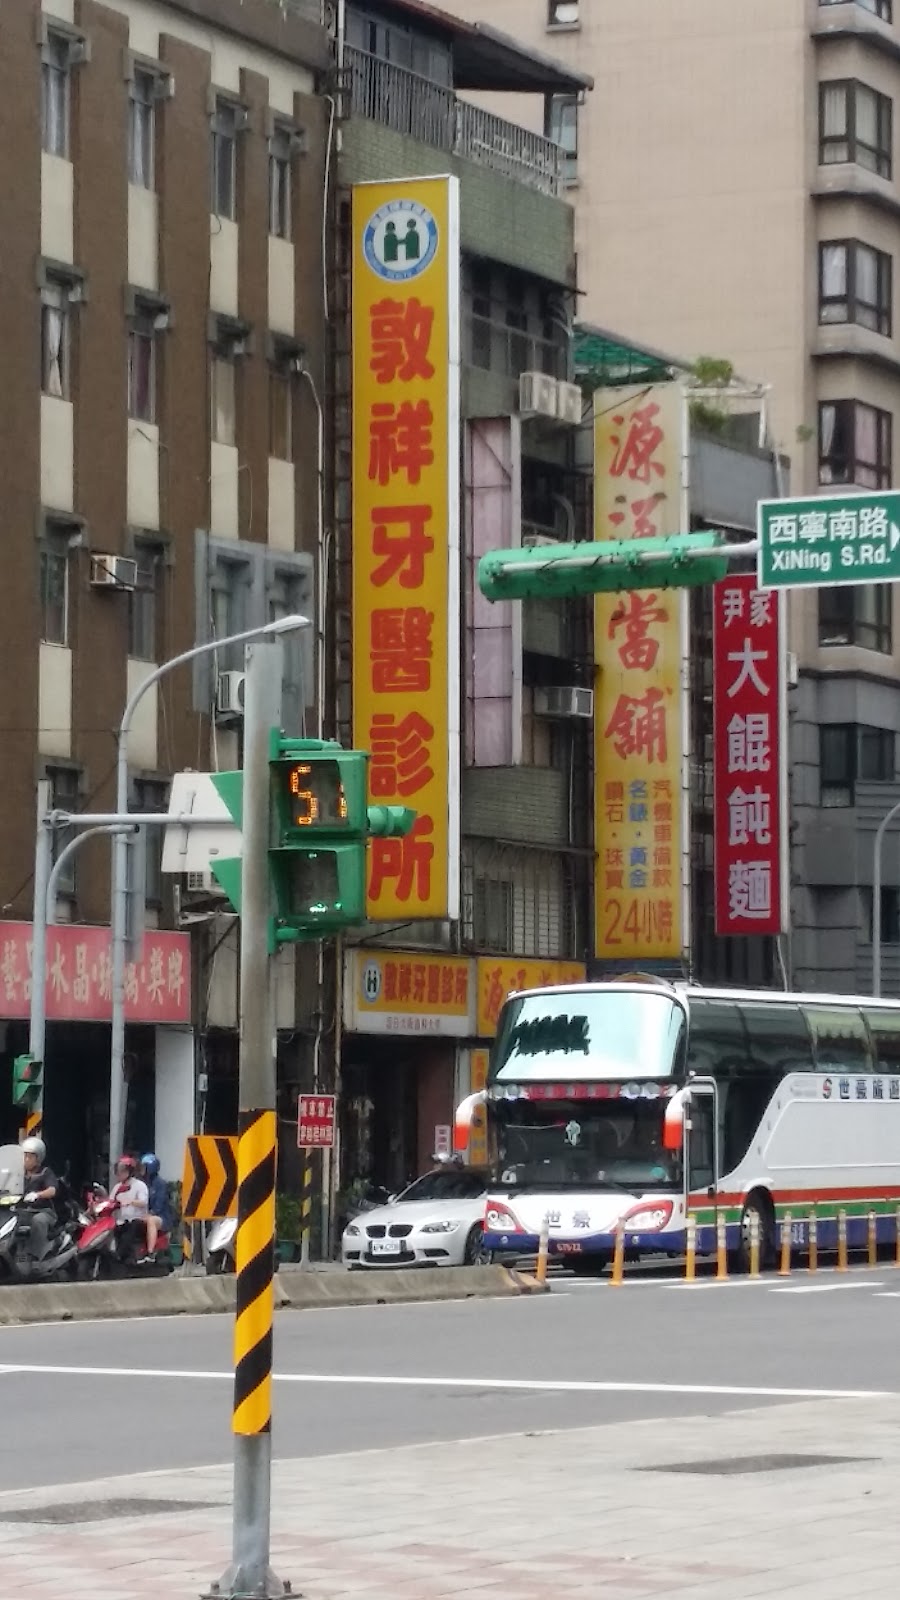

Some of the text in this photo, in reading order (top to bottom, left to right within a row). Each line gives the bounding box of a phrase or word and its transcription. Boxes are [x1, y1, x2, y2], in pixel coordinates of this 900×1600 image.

[769, 507, 888, 545] 西寧南路
[771, 549, 831, 572] XiNing
[367, 297, 435, 901] 敦祥牙醫診所
[723, 588, 773, 628] 尹家
[727, 637, 772, 919] 大餛飩麵
